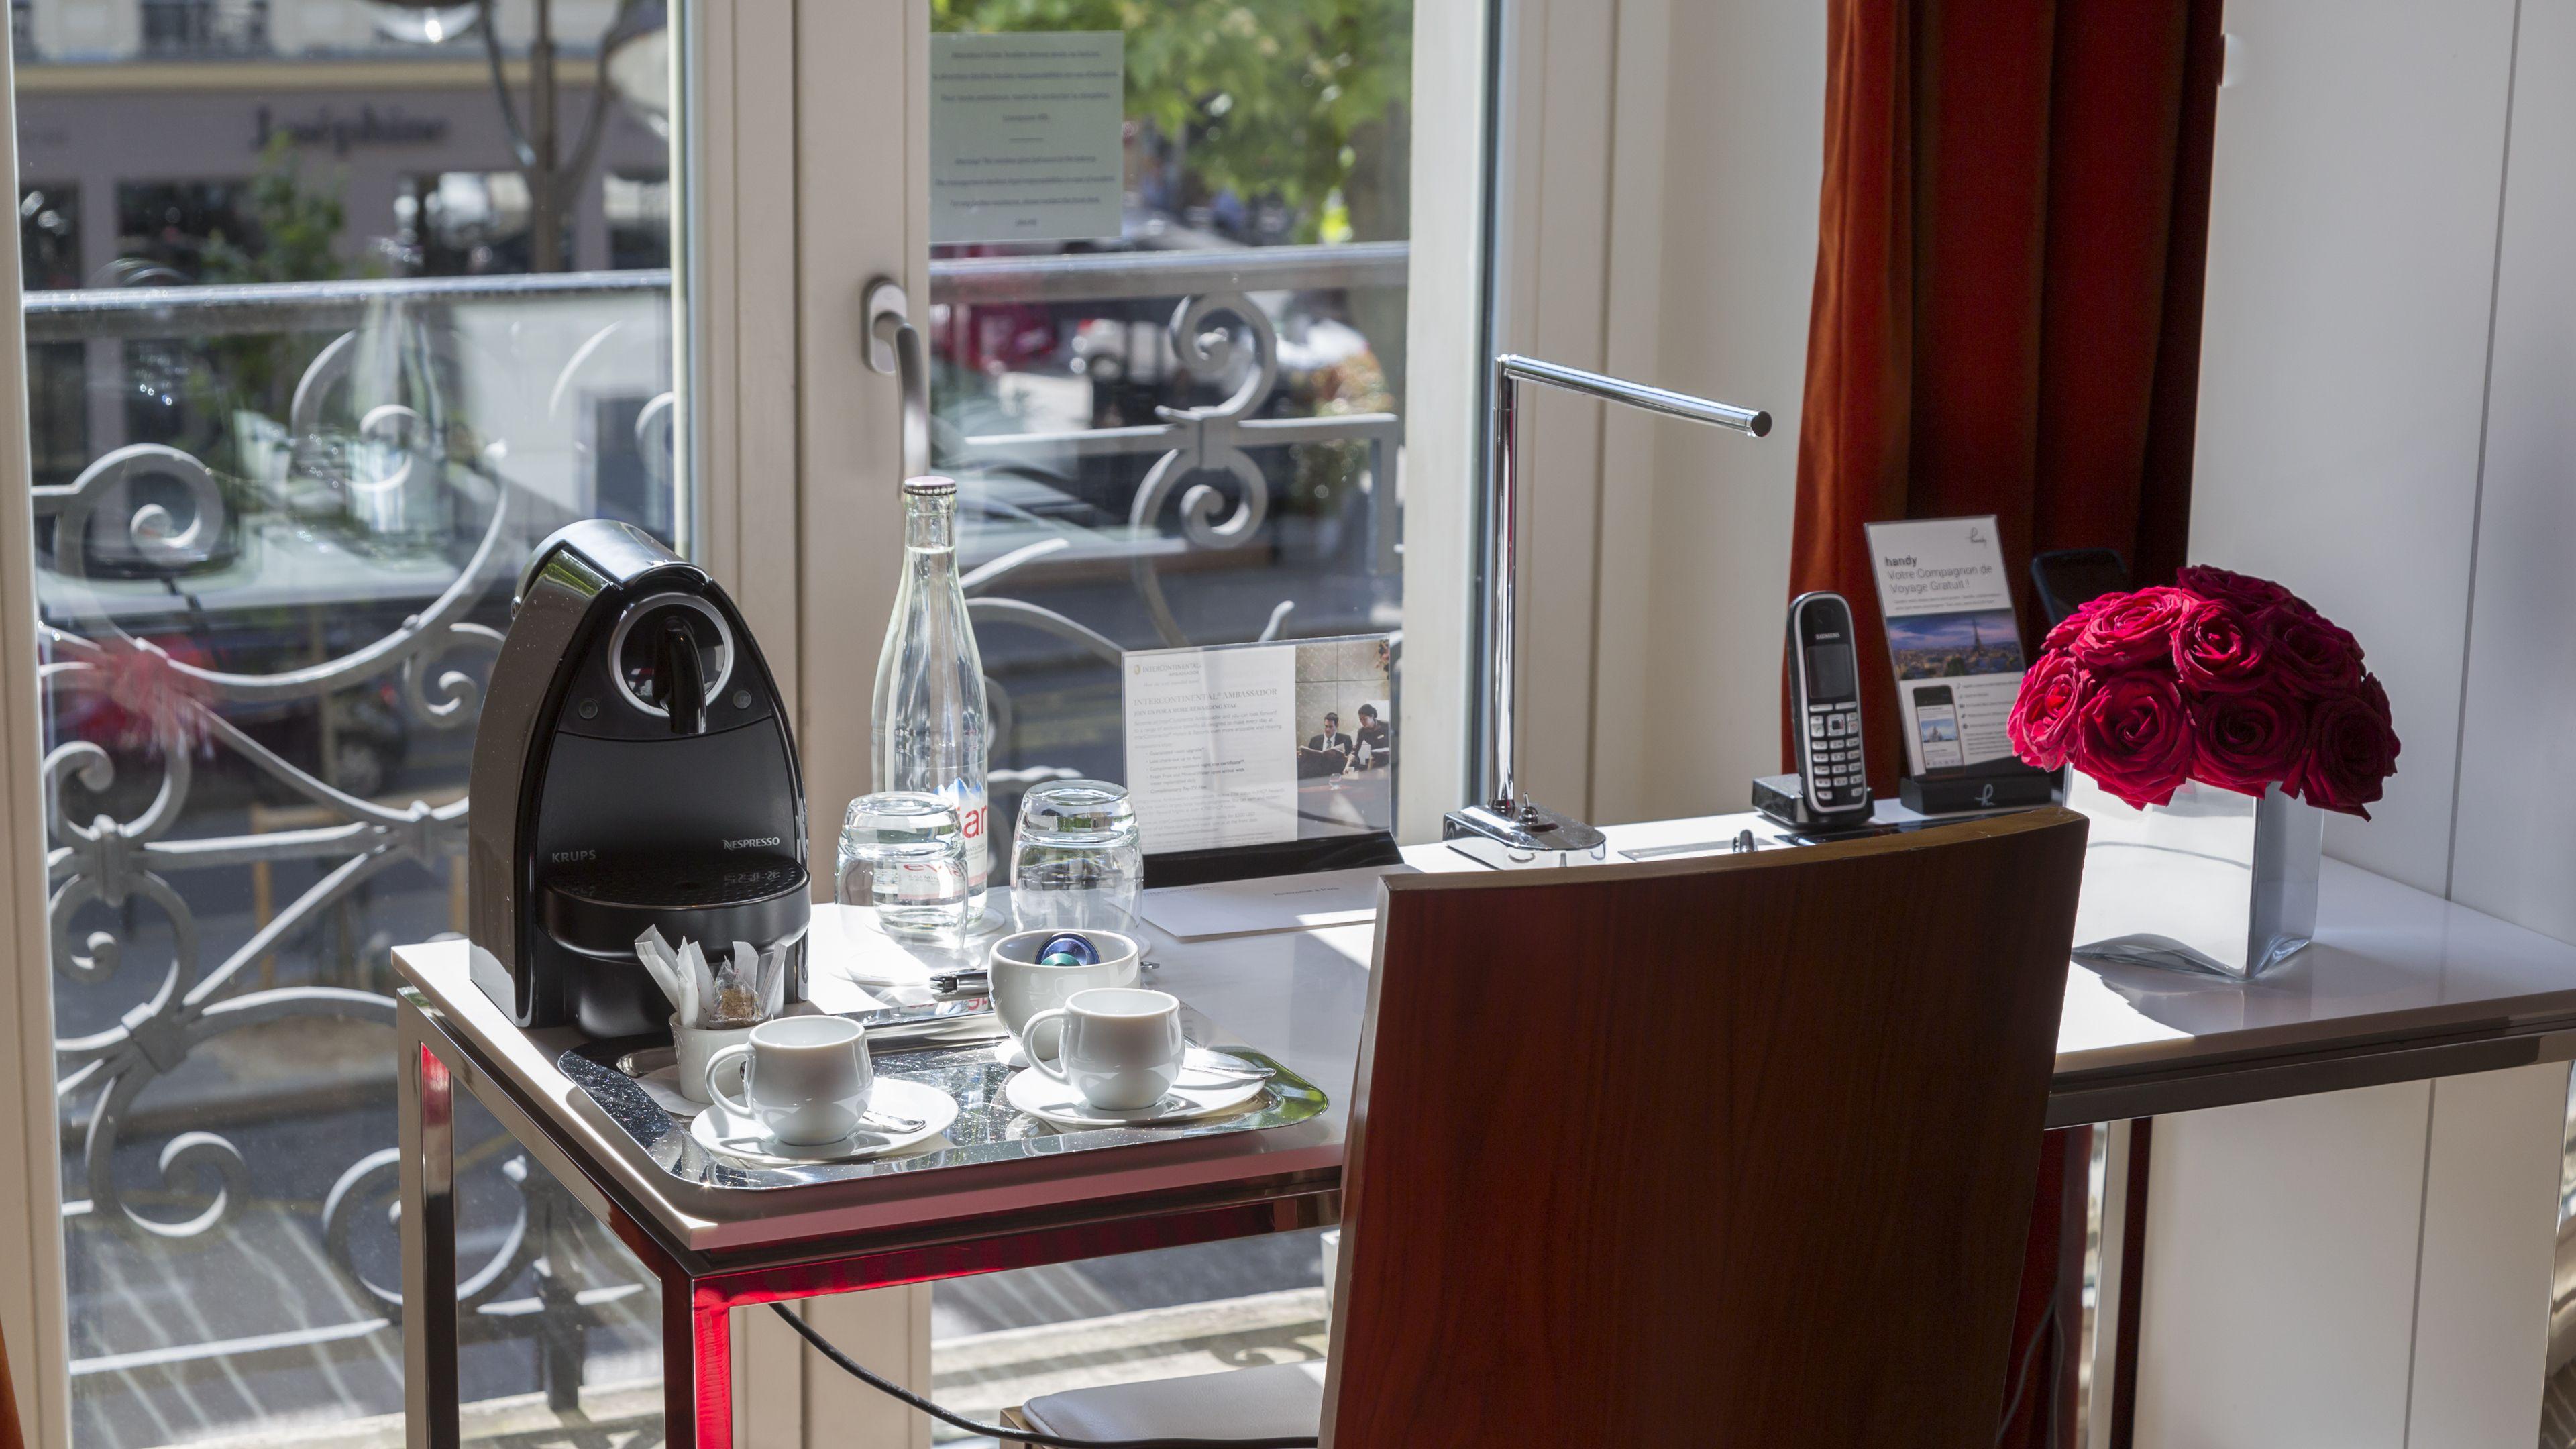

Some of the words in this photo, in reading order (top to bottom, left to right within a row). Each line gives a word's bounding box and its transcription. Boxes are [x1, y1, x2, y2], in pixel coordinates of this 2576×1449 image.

[1884, 555, 1917, 568] handy
[1888, 569, 1915, 580] Votre
[1917, 566, 1978, 579] Compagnon
[1980, 564, 1992, 575] de
[1890, 582, 1929, 595] Voyage
[1930, 579, 1964, 591] Gratuit
[1142, 662, 1199, 673] INTERCONTINENTAL
[1224, 688, 1277, 699] AMBASSADOR
[723, 837, 780, 851] NESPRESSO
[551, 849, 596, 863] KRUPS
